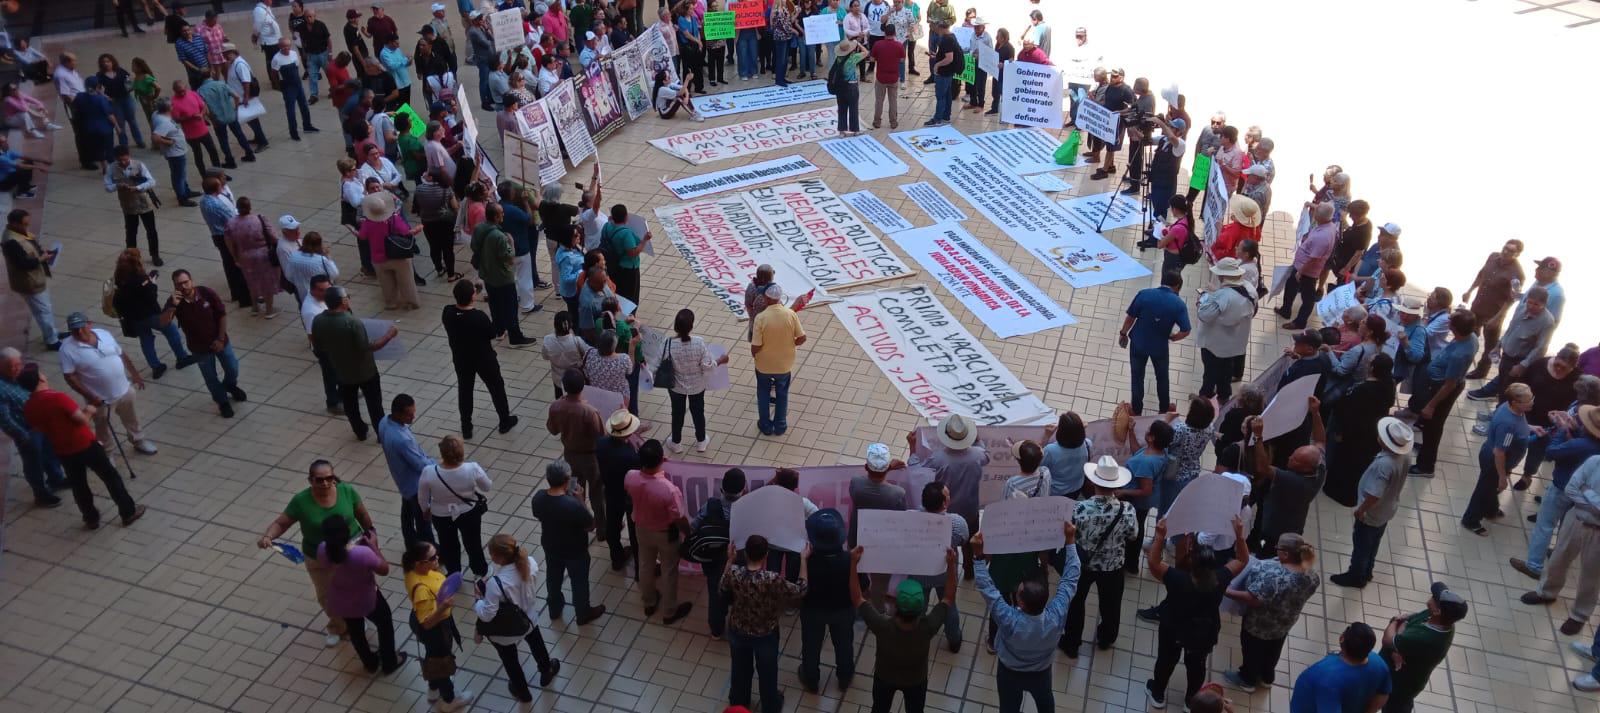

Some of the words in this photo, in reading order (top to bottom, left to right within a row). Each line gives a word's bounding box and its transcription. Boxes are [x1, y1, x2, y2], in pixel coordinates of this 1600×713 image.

[1016, 68, 1051, 79] Gobierne
[1022, 80, 1044, 88] quien
[1014, 86, 1050, 98] gobierne,
[1021, 97, 1053, 106] contrato
[772, 109, 838, 126] RESPET
[1014, 113, 1049, 124] defiende
[687, 148, 718, 160] DE
[728, 128, 837, 154] JUBILACIO
[695, 138, 722, 150] MI
[713, 178, 724, 186] del
[971, 161, 1005, 184] DERECHOS
[760, 201, 787, 216] LA
[948, 164, 980, 186] RECURSOS
[992, 199, 1037, 232] UNIVERSIDAD
[798, 178, 820, 195] NO
[817, 194, 833, 206] A
[827, 202, 852, 226] LAS
[846, 224, 904, 277] POLITICAS
[1008, 201, 1040, 222] MANEJO
[1043, 228, 1062, 239] LOS
[1046, 208, 1085, 235] NUESTROS
[673, 208, 735, 280] TRABAJADORES
[780, 191, 875, 280] NEOLIBERALES
[737, 259, 758, 270] DE
[674, 242, 703, 274] NEGOCIA
[699, 274, 717, 289] CON
[713, 288, 731, 300] LA
[723, 299, 745, 316] SEP
[953, 255, 971, 264] LAS
[1006, 300, 1024, 309] DE
[1015, 308, 1033, 316] LA
[848, 304, 904, 362] ACTIVOS
[901, 286, 948, 328] PRIMA
[944, 331, 1020, 408] VACACIONAL
[878, 297, 958, 374] COMPLETA
[952, 382, 1008, 426] PARA
